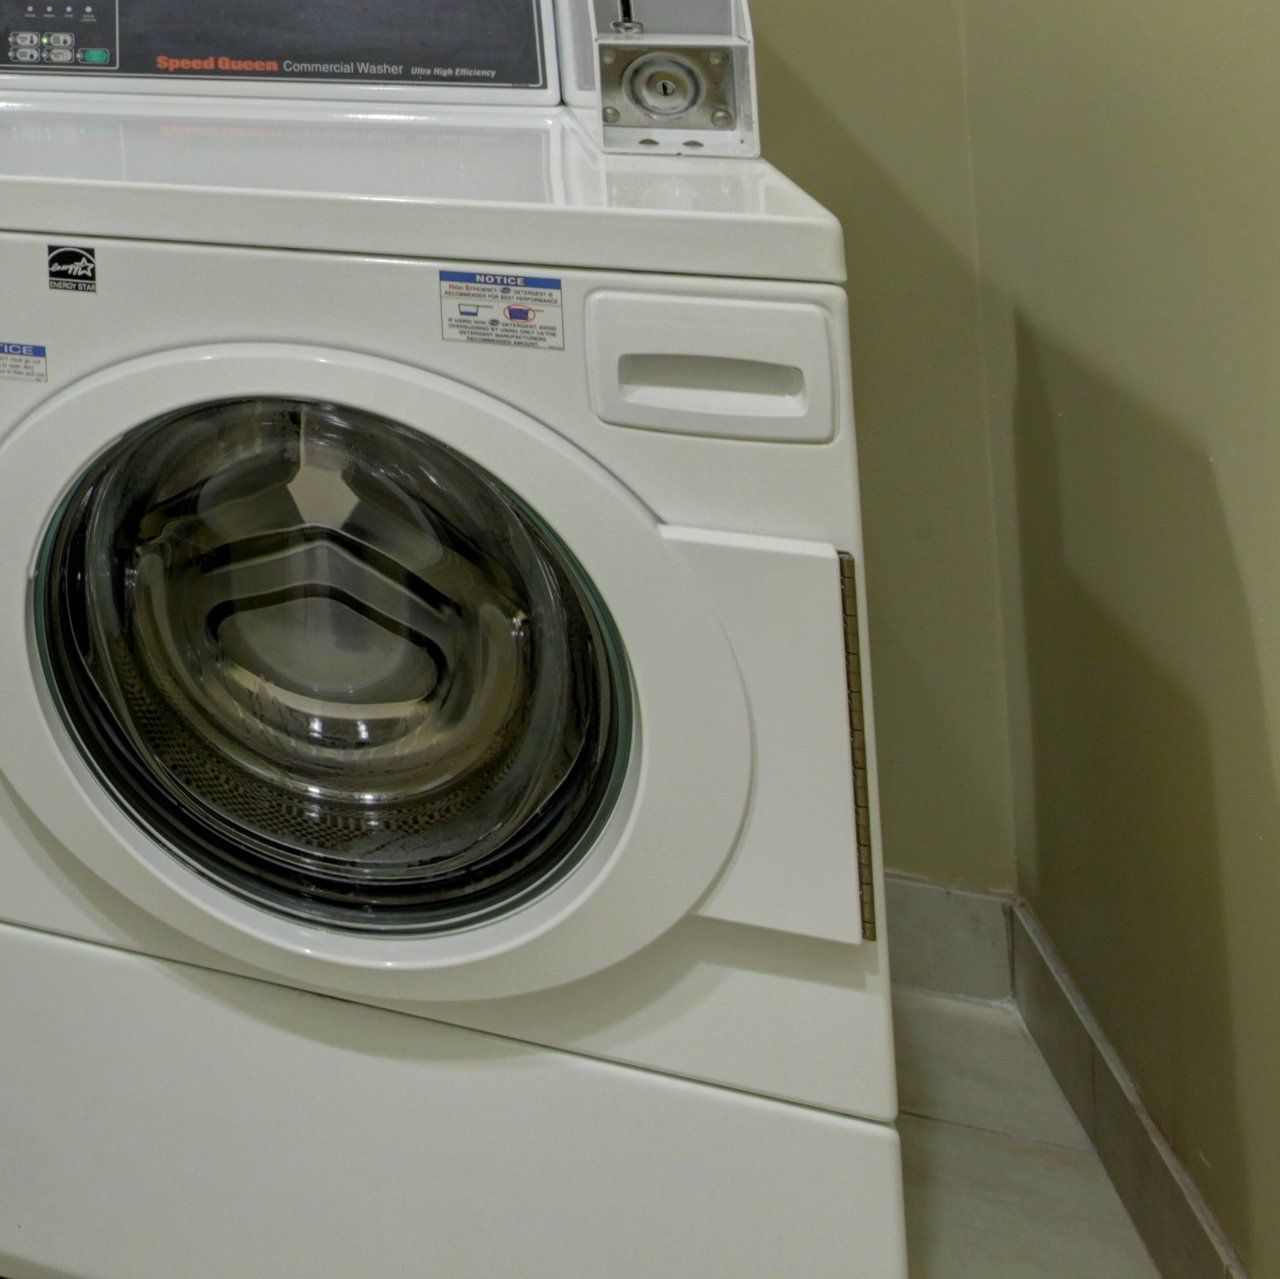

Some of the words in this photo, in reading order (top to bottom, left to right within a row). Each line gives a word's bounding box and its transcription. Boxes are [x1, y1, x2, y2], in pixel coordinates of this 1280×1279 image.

[155, 55, 215, 72] Speed
[217, 56, 279, 71] Queen
[282, 60, 354, 74] Commercial
[356, 62, 404, 75] Washer
[410, 66, 432, 75] Ultra
[433, 67, 454, 77] High
[455, 67, 497, 78] Efficiency
[49, 280, 77, 290] ENERGY
[77, 282, 97, 292] STAR
[475, 273, 525, 286] NOTICE
